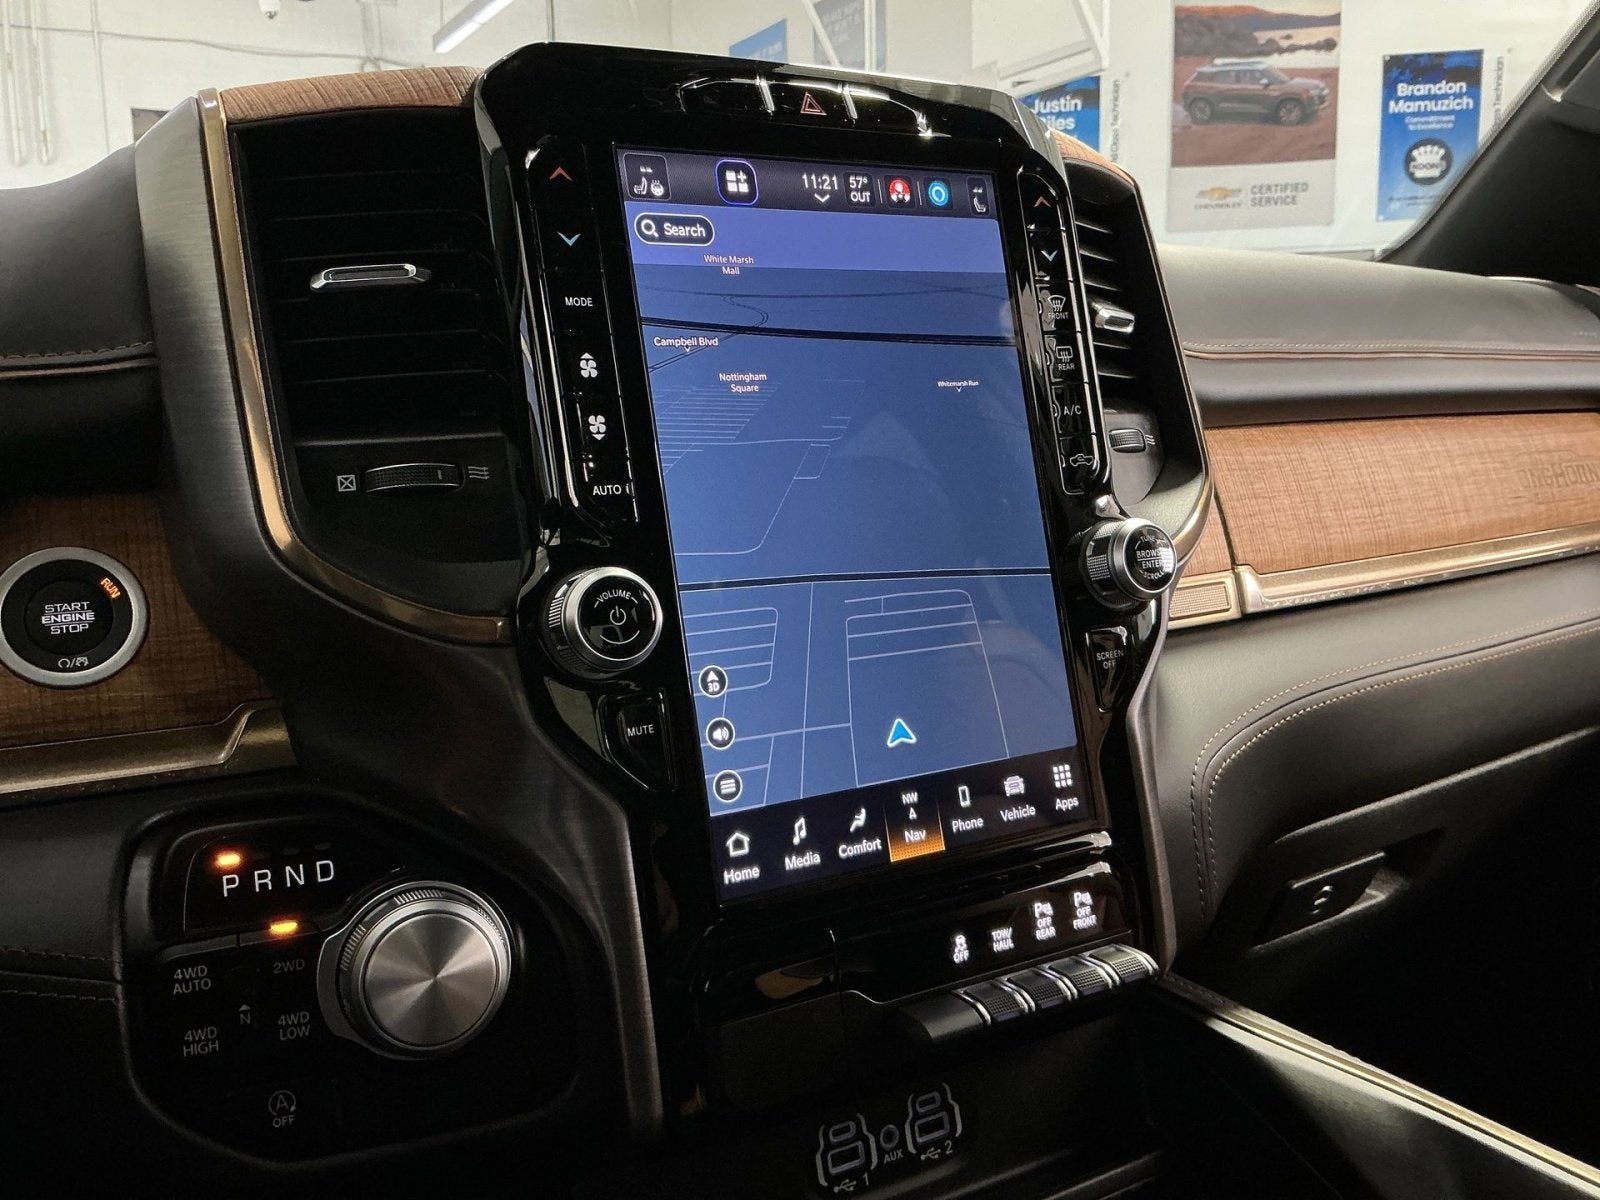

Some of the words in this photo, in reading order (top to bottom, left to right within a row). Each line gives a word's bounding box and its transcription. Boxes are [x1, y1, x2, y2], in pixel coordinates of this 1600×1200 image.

[1397, 80, 1467, 97] Brandon
[1032, 95, 1082, 114] Justin
[1111, 79, 1120, 126] Technician
[1389, 96, 1474, 114] Mamuzich
[802, 173, 838, 190] 11:21
[849, 175, 868, 189] 57°
[1250, 182, 1309, 195] CERTIFIED
[850, 190, 870, 203] OUT
[1250, 195, 1298, 207] SERVICE
[663, 222, 706, 237] Search
[703, 254, 726, 264] White
[728, 255, 754, 265] Marsh
[722, 265, 740, 275] Mall
[565, 297, 593, 308] MODE
[1048, 312, 1069, 320] FRONT
[653, 336, 697, 348] Campbell
[698, 336, 719, 347] Blvd
[1058, 362, 1075, 371] REAR
[719, 372, 767, 383] Nottingham
[730, 384, 759, 394] Square
[1063, 404, 1082, 416] A/C
[592, 483, 622, 496] AUTO
[1140, 535, 1156, 543] TUNE
[1136, 548, 1163, 559] BROWS
[100, 577, 121, 599] RUN
[596, 589, 632, 604] VOLUME
[44, 601, 90, 613] START
[41, 612, 95, 625] ENGINE
[50, 624, 89, 635] STOP
[1096, 649, 1124, 662] SCREEN
[1103, 659, 1117, 670] OFF
[707, 682, 720, 693] 3D
[627, 724, 655, 736] MUTE
[901, 791, 918, 805] NW
[723, 866, 760, 885] Home
[784, 852, 821, 871] Media
[838, 838, 882, 859] Comfort
[904, 829, 926, 843] Nav
[952, 817, 984, 833] Phone
[1000, 805, 1036, 823] Vehicle
[1055, 797, 1079, 812] Apps
[222, 874, 240, 897] P
[254, 869, 272, 892] R
[285, 863, 305, 888] N
[316, 859, 335, 883] D
[1076, 905, 1092, 918] OFF
[1036, 917, 1052, 929] OFF
[1072, 914, 1097, 930] FRONT
[991, 927, 1013, 942] TOW/
[1035, 926, 1056, 941] REAR
[993, 938, 1014, 953] HAUL
[953, 950, 970, 964] OFF
[173, 964, 208, 980] 4WD
[273, 958, 305, 974] 2WD
[172, 978, 212, 995] AUTO
[277, 1011, 310, 1026] 4WD
[184, 1026, 218, 1042] 4WD
[279, 1024, 311, 1041] LOW
[183, 1040, 219, 1056] HIGH
[272, 1114, 295, 1128] OFF
[944, 1140, 953, 1155] 2
[883, 1148, 904, 1164] AUX
